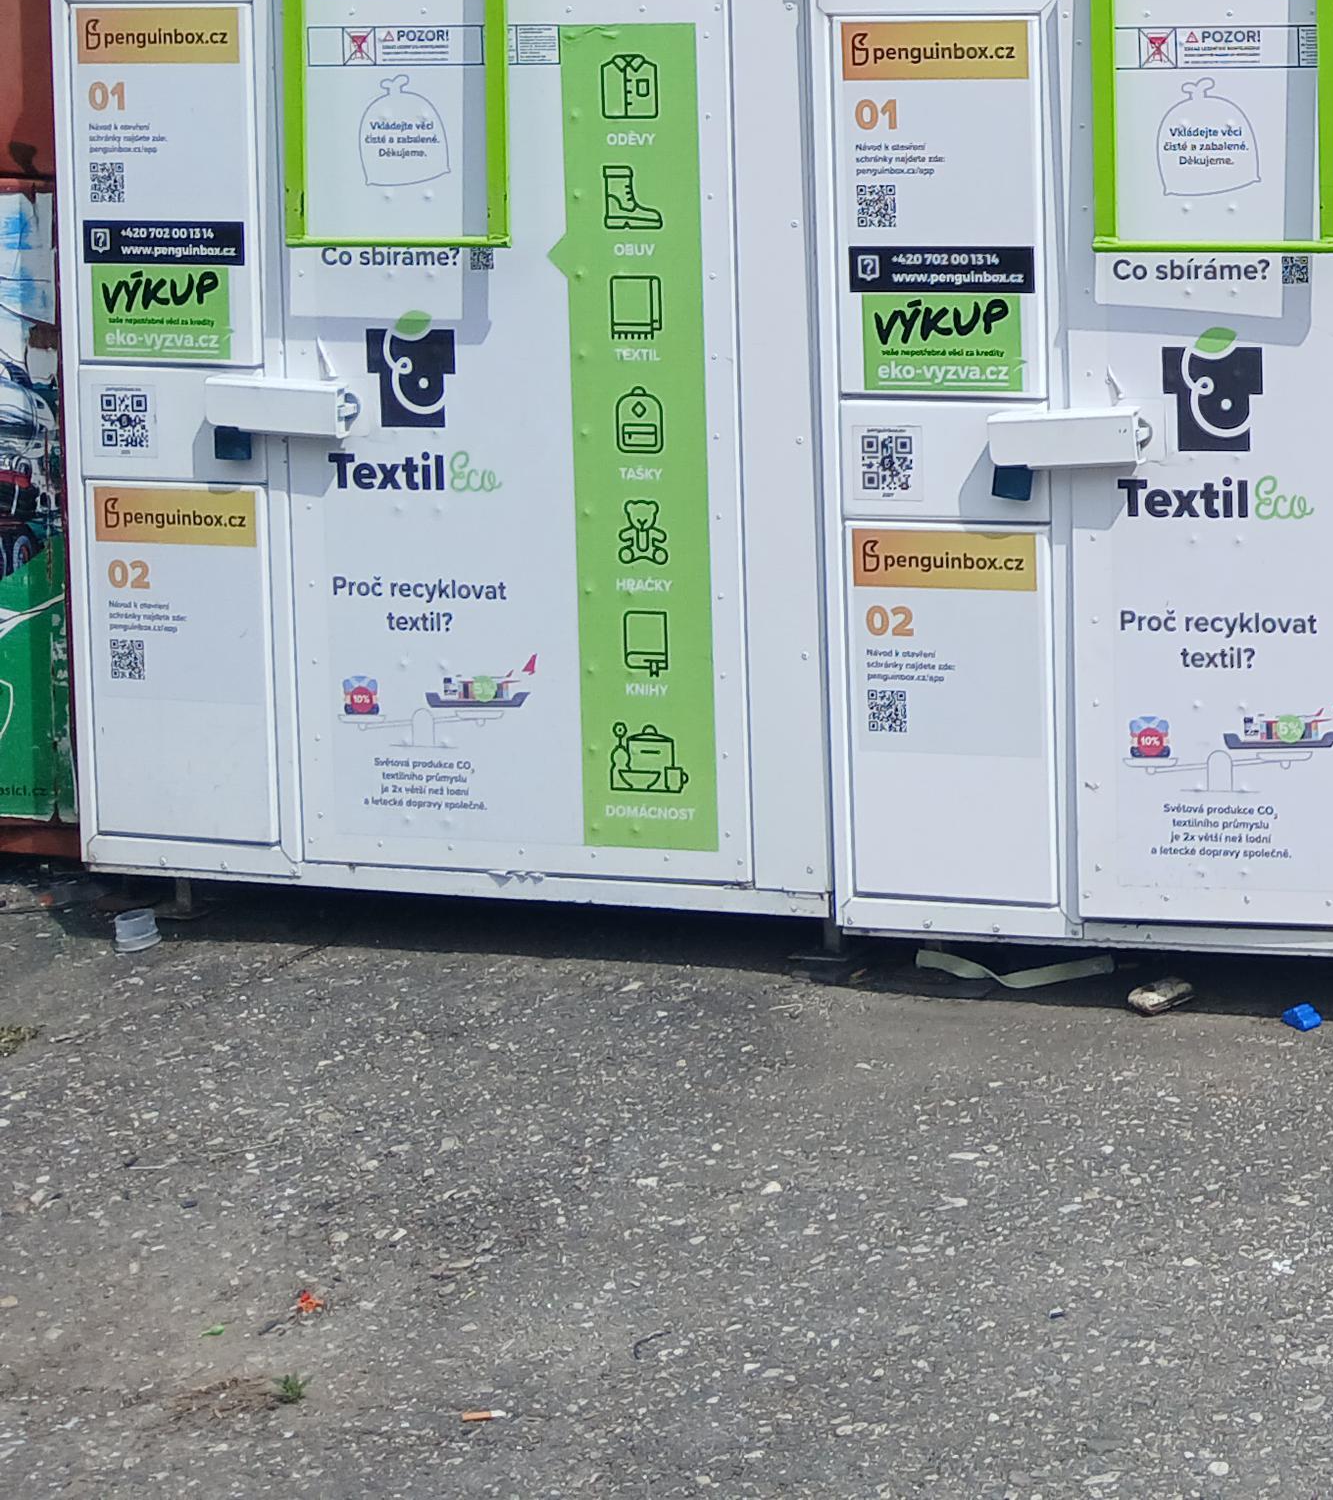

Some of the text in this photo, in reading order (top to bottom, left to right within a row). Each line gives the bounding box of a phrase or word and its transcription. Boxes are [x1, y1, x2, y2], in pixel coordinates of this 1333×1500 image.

[104, 27, 228, 49] penguinbox.cz
[397, 29, 450, 42] POZOR!
[1201, 30, 1261, 43] POZOR!
[873, 42, 1016, 64] penguinbox.cz
[88, 80, 126, 111] 01
[854, 98, 898, 130] 01
[607, 130, 656, 147] ODĚVY
[1169, 127, 1218, 139] Vkládejte
[1179, 155, 1235, 167] Děkujeme.
[120, 228, 147, 239] +420
[149, 228, 170, 239] 702
[171, 228, 187, 239] 00
[120, 244, 237, 258] www.penguinbox.cz
[321, 247, 460, 266] Co sbíráme?
[613, 243, 656, 257] OBUV
[891, 253, 922, 265] +420
[924, 253, 949, 265] 702
[951, 253, 968, 265] 00
[892, 271, 1024, 286] www.penguinbox.cz
[1113, 257, 1270, 281] Co sbíráme?
[101, 270, 219, 314] VÝKUP
[874, 298, 1009, 346] VÝKUP
[105, 329, 219, 350] eko-vyzva.cz
[616, 349, 661, 362] TEXTIL
[877, 362, 1010, 383] eko-vyzva.cz
[619, 465, 662, 481] TAŠKY
[123, 509, 246, 529] penguinbox.cz
[883, 552, 1024, 573] penguinbox.cz
[107, 559, 151, 589] 02
[332, 575, 507, 603] Proč recyklovat
[615, 576, 673, 592] HRAČKY
[386, 611, 453, 632] textil?
[865, 604, 915, 637] 02
[1119, 610, 1318, 639] Proč recyklovat
[1180, 646, 1256, 669] textil?
[625, 683, 669, 697] KNIHY
[1140, 736, 1161, 746] 10%
[605, 802, 695, 821] DOMÁCNOST
